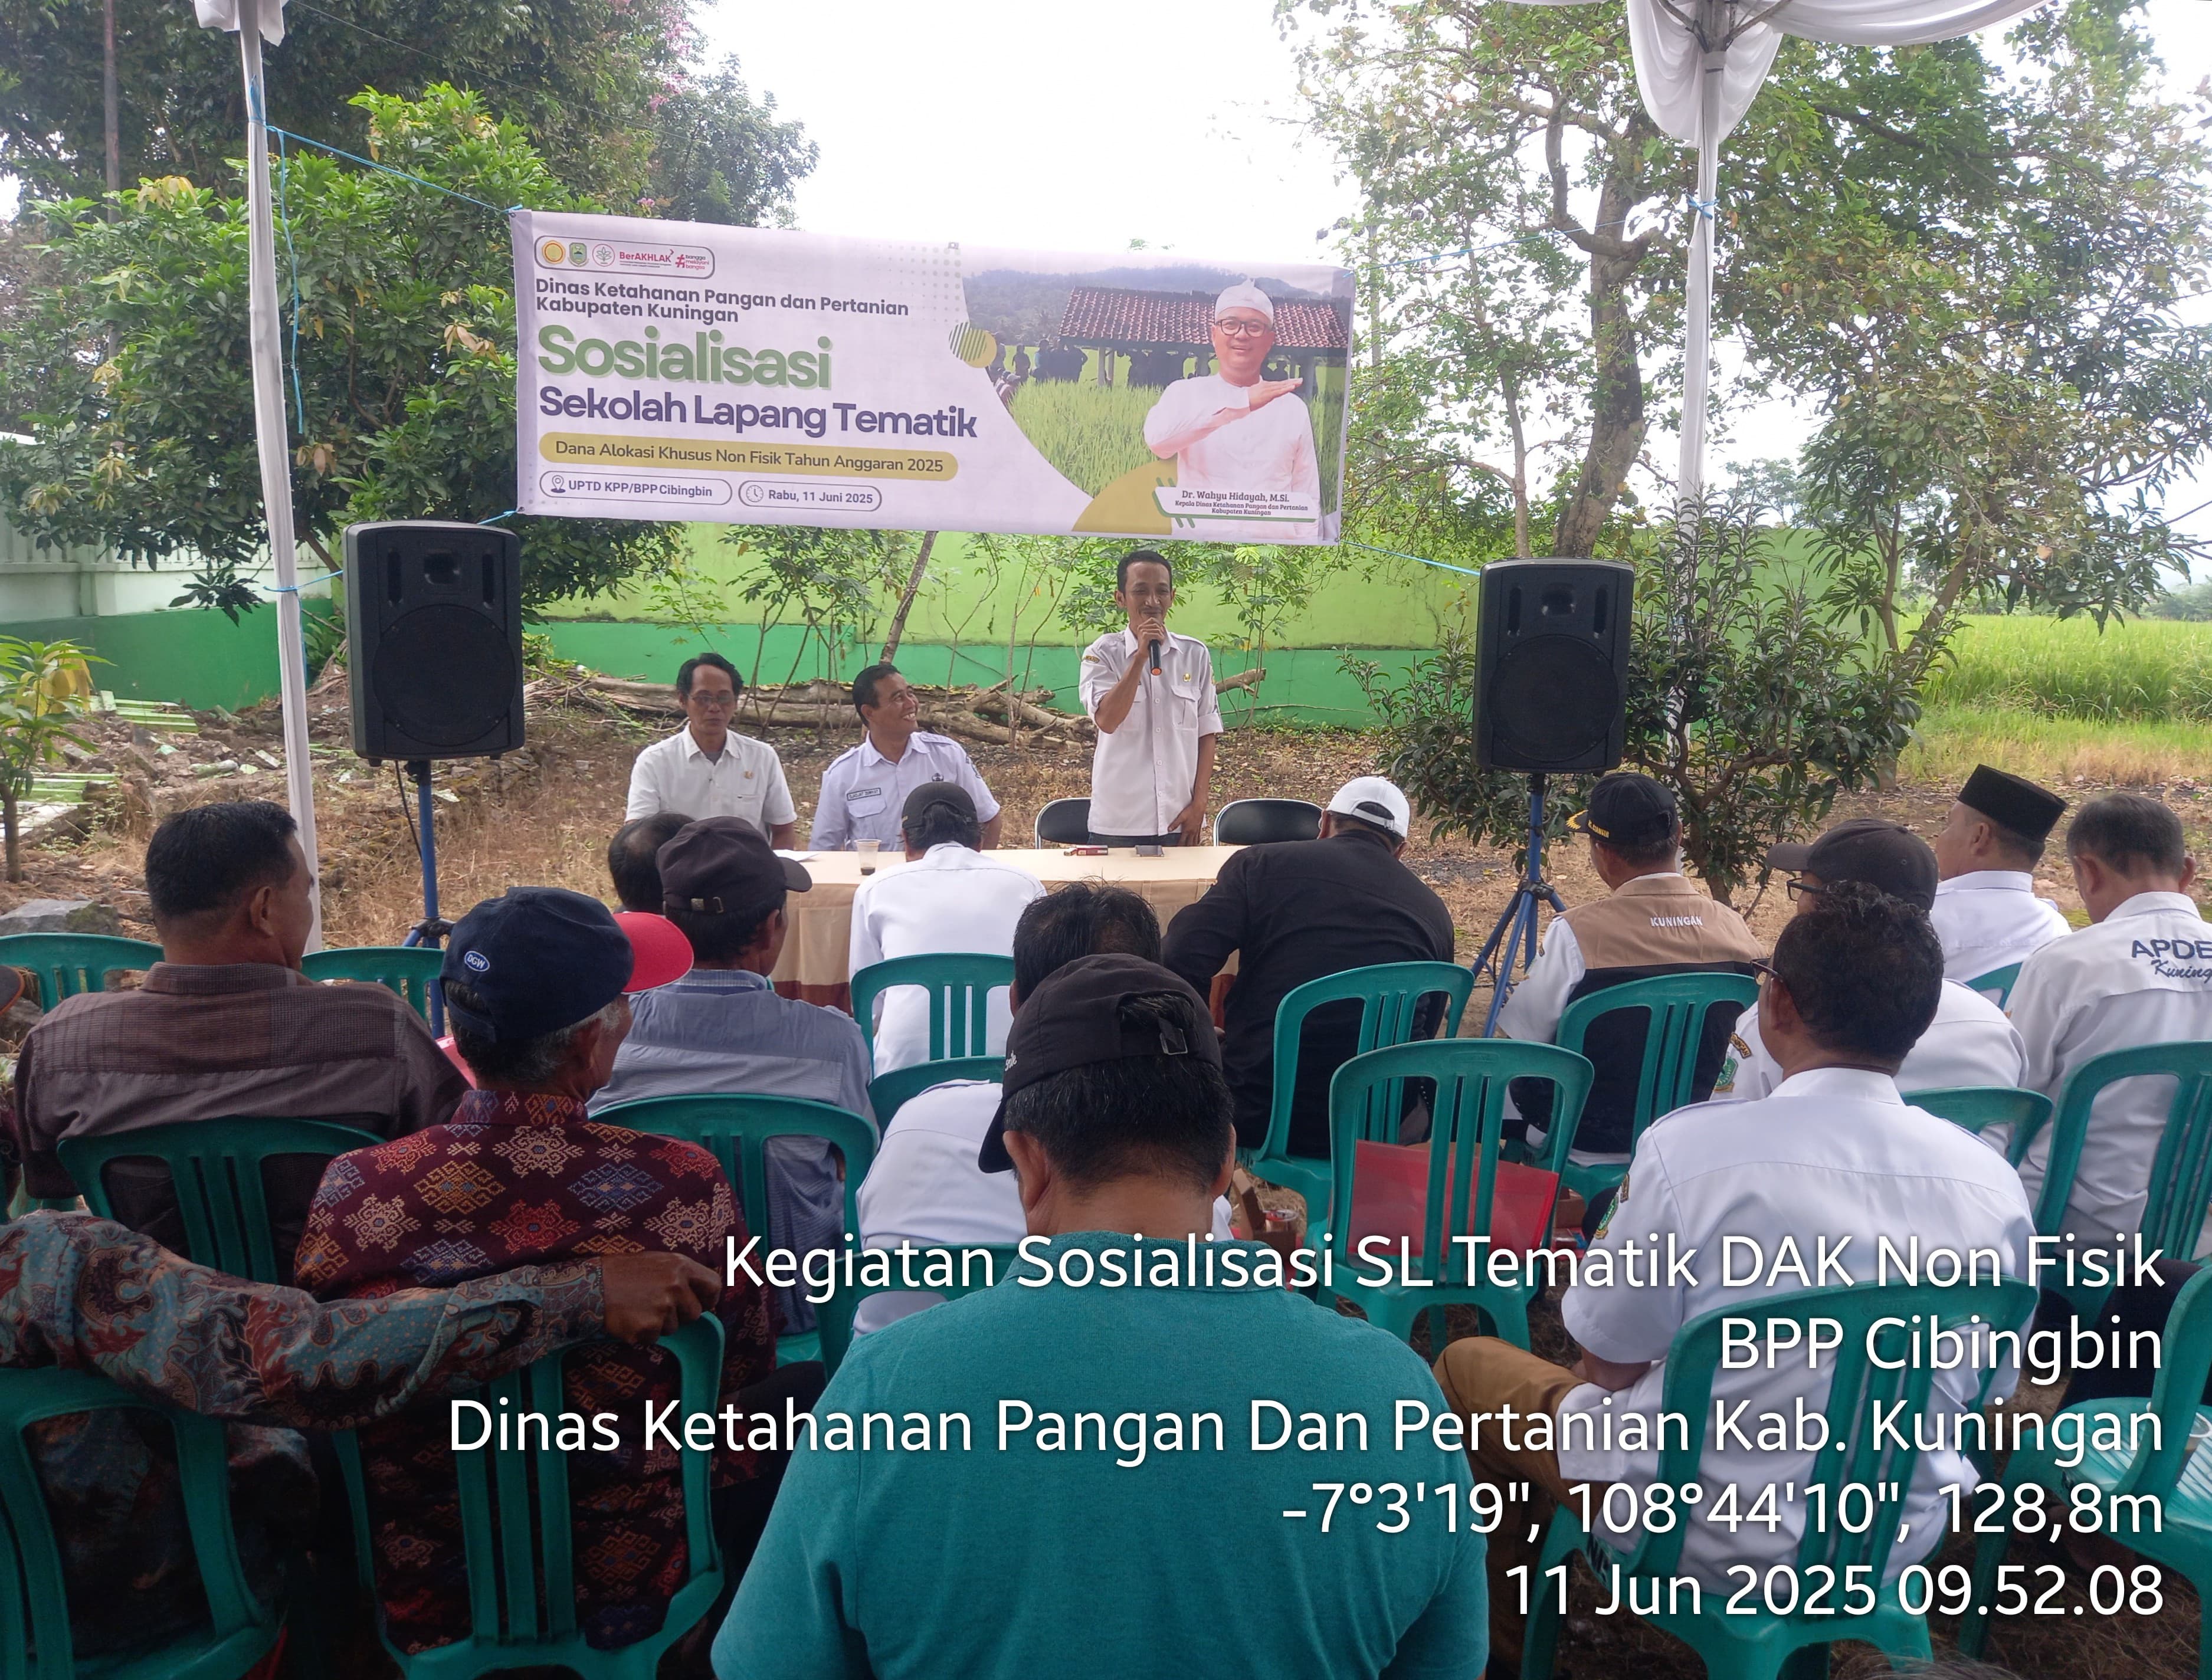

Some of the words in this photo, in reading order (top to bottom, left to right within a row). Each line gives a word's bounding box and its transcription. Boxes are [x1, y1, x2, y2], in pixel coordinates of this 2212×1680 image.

[620, 252, 671, 262] BerAKHLAK
[536, 278, 590, 296] Dinas
[595, 282, 699, 303] Ketahanan
[704, 288, 775, 310] Pangan
[781, 293, 816, 310] dan
[821, 297, 908, 316] Pertanian
[536, 296, 643, 318] Kabupaten
[648, 303, 739, 325] Kuningan
[538, 325, 833, 389] Sosialisasi
[540, 386, 686, 423] Sekolah
[695, 396, 826, 438] Lapang
[833, 402, 977, 438] Tematik
[556, 441, 595, 456] Dana
[599, 443, 654, 458] Alokasi
[658, 447, 712, 462] Khusus
[716, 450, 745, 464] Non
[750, 452, 782, 466] Fisik
[785, 452, 830, 467] Tahun
[834, 455, 903, 471] Anggaran
[907, 458, 943, 472] 2025
[568, 480, 601, 492] UPTD
[658, 484, 713, 499] Cibingbin
[768, 489, 801, 503] Rabu,
[803, 490, 816, 502] 11
[819, 491, 843, 503] Juni
[846, 493, 873, 504] 2025
[1182, 490, 1195, 499] Dr.
[1197, 491, 1227, 501] Wahyu
[1229, 493, 1268, 503] Hidayah,
[1270, 494, 1290, 503] M.Si.
[1650, 916, 1703, 927] KUNINGAN
[2131, 939, 2212, 959] APDE
[467, 954, 486, 969] DGW
[2150, 959, 2212, 984] Kuning
